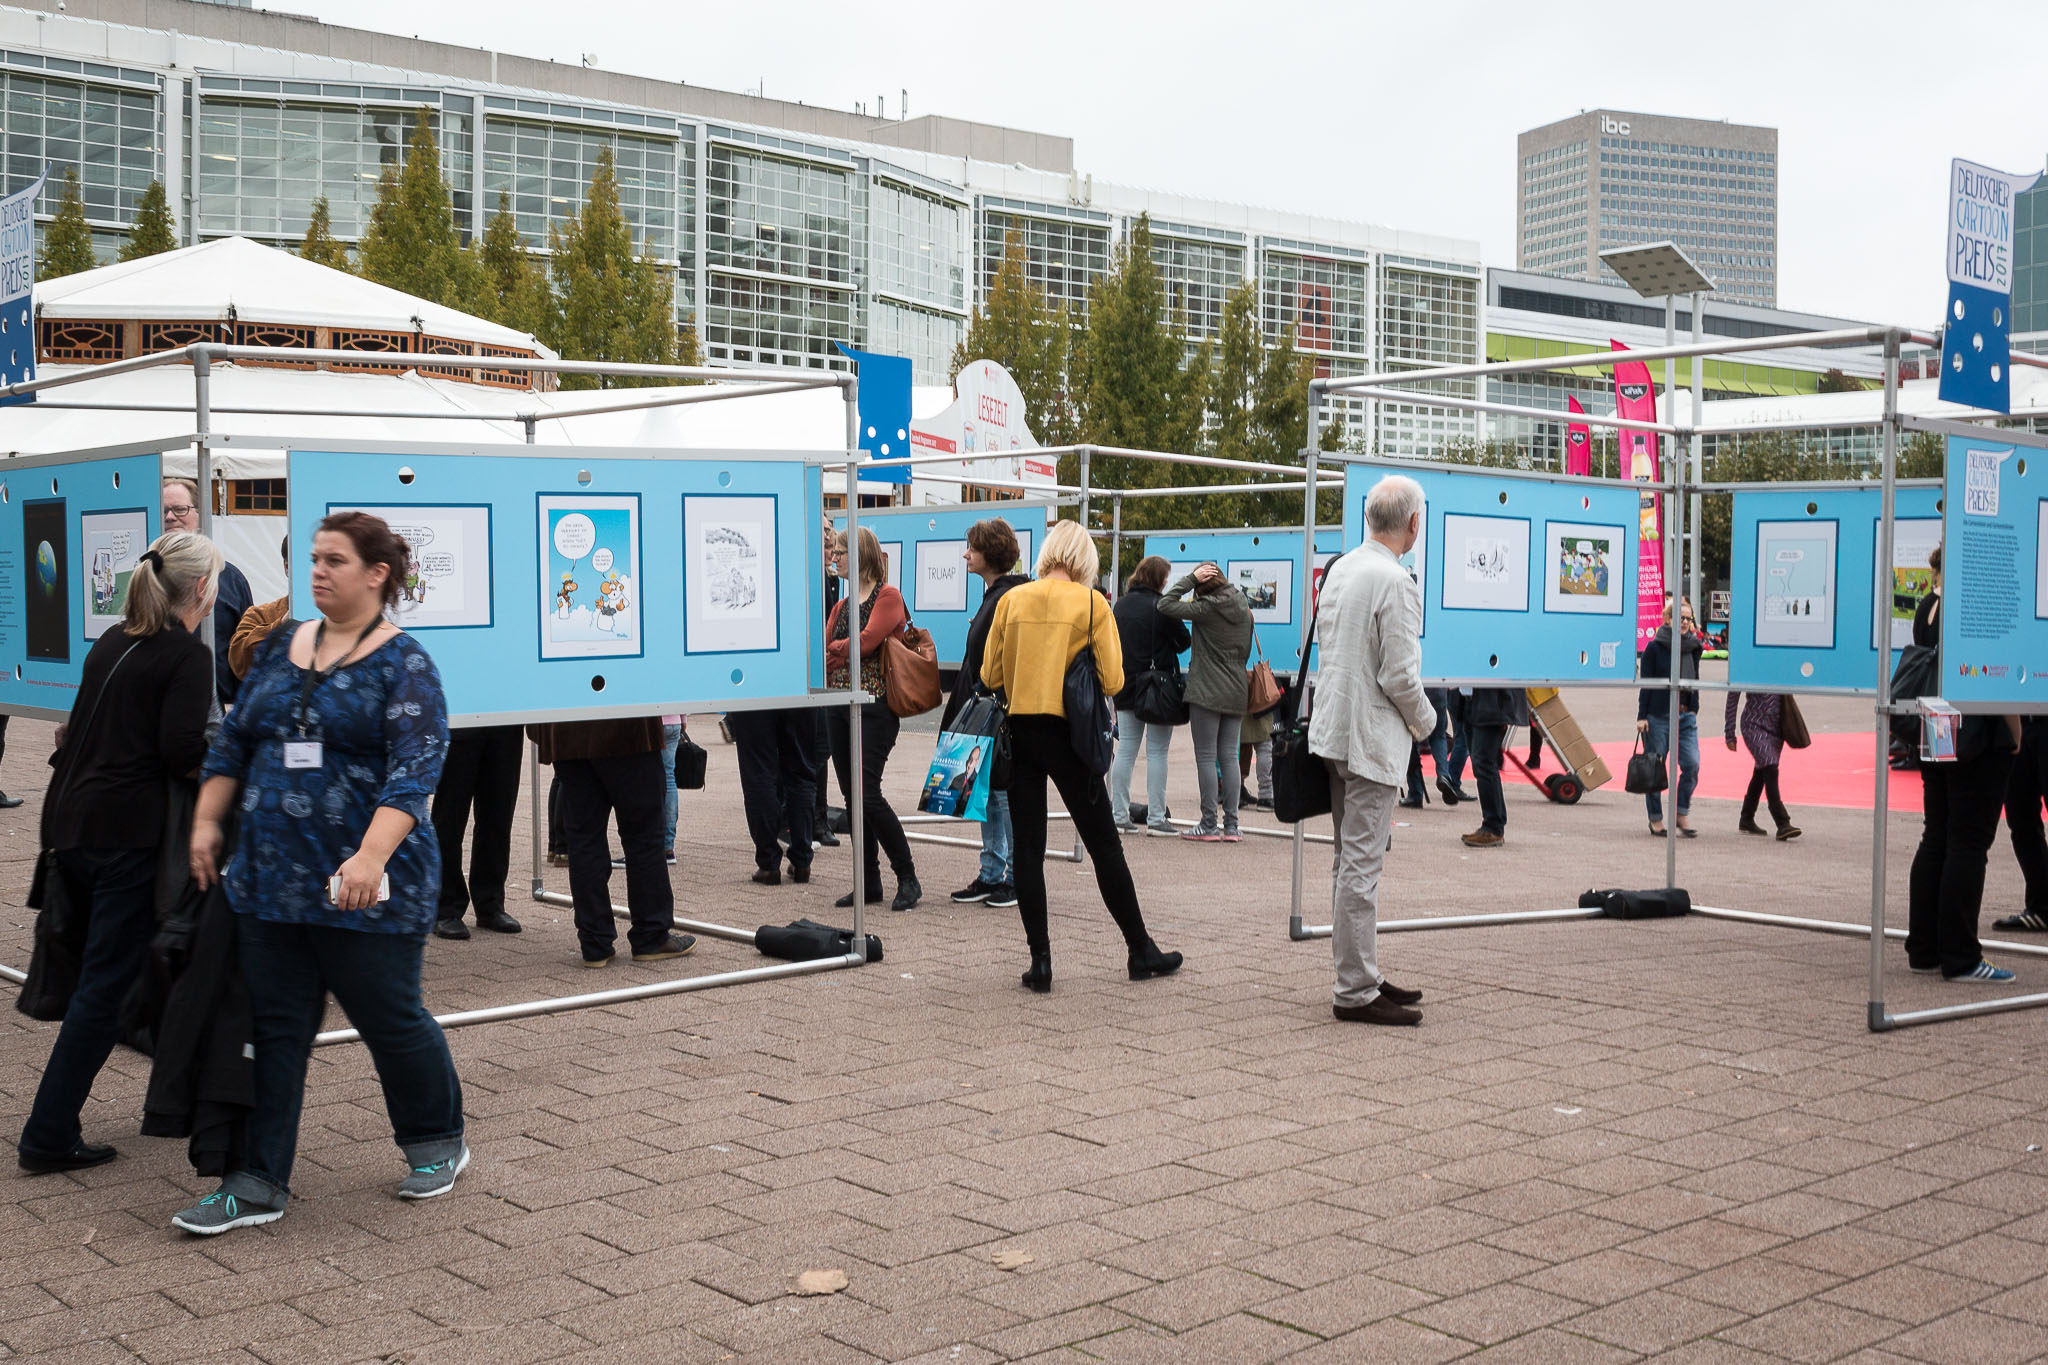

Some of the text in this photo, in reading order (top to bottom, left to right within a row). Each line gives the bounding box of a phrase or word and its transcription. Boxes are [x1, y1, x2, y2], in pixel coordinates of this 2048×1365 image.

[1601, 115, 1630, 136] ibc
[1958, 167, 2010, 208] DEUTSCHER
[1, 222, 29, 258] CARTOON
[1956, 198, 2009, 242] CARTOON
[1, 257, 22, 298] PREIS
[1955, 233, 1995, 282] PREIS
[1996, 244, 2007, 287] 2017
[978, 392, 1008, 428] LESEZELT
